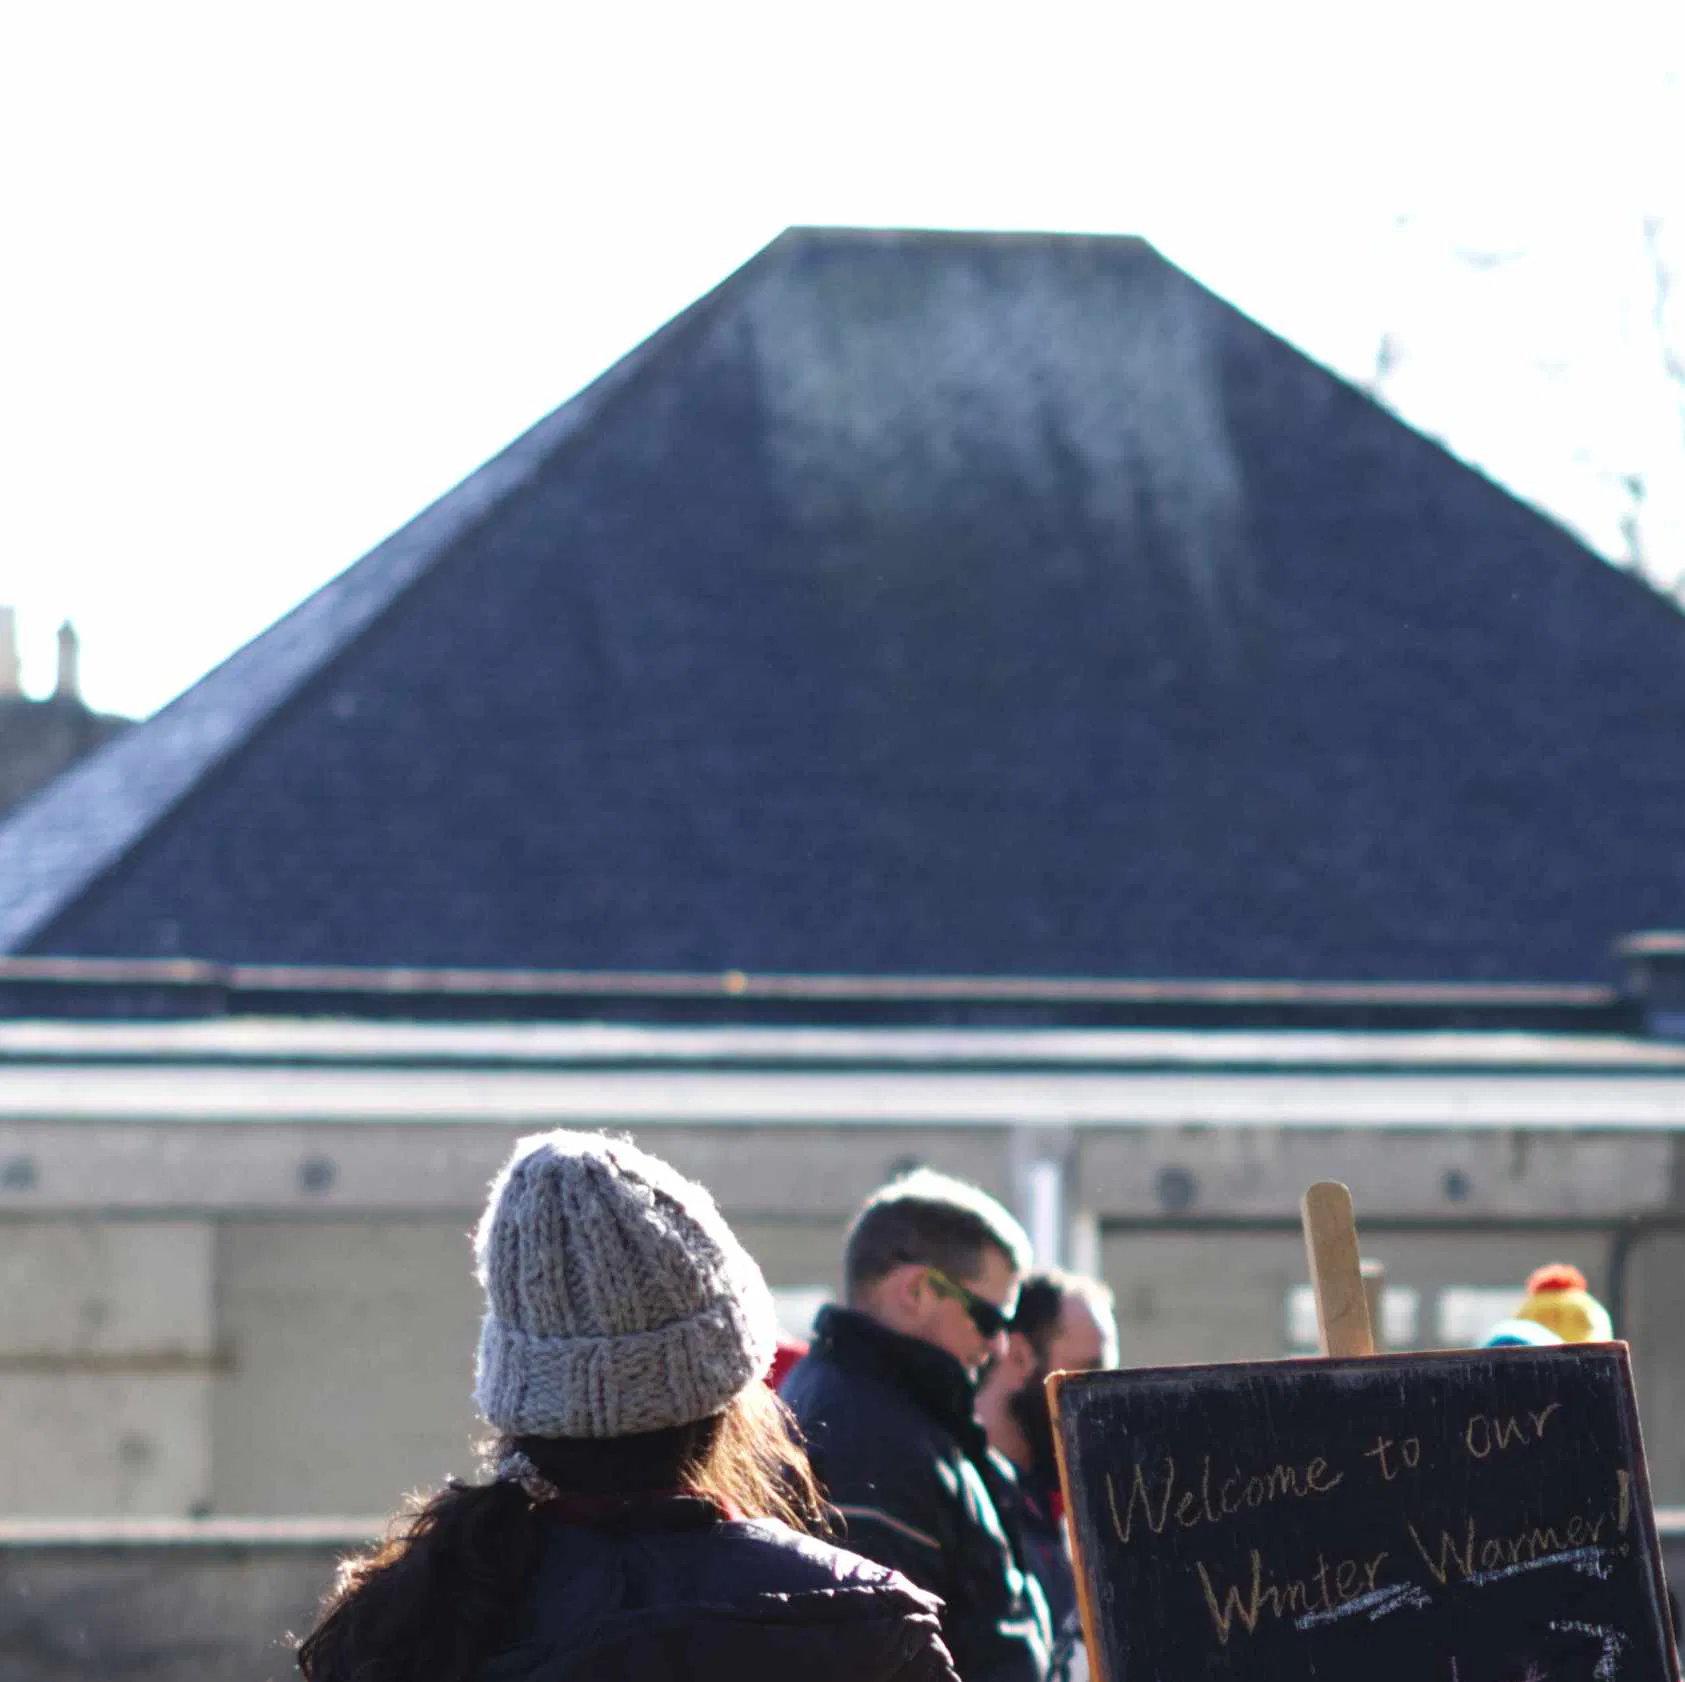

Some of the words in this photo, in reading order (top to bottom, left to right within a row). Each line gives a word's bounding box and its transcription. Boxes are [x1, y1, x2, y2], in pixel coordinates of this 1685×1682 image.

[1105, 1454, 1345, 1543] Welcome
[1364, 1435, 1420, 1481] to
[1466, 1402, 1564, 1458] our
[1197, 1548, 1390, 1645] Winter
[1407, 1468, 1631, 1585] Warmer!
